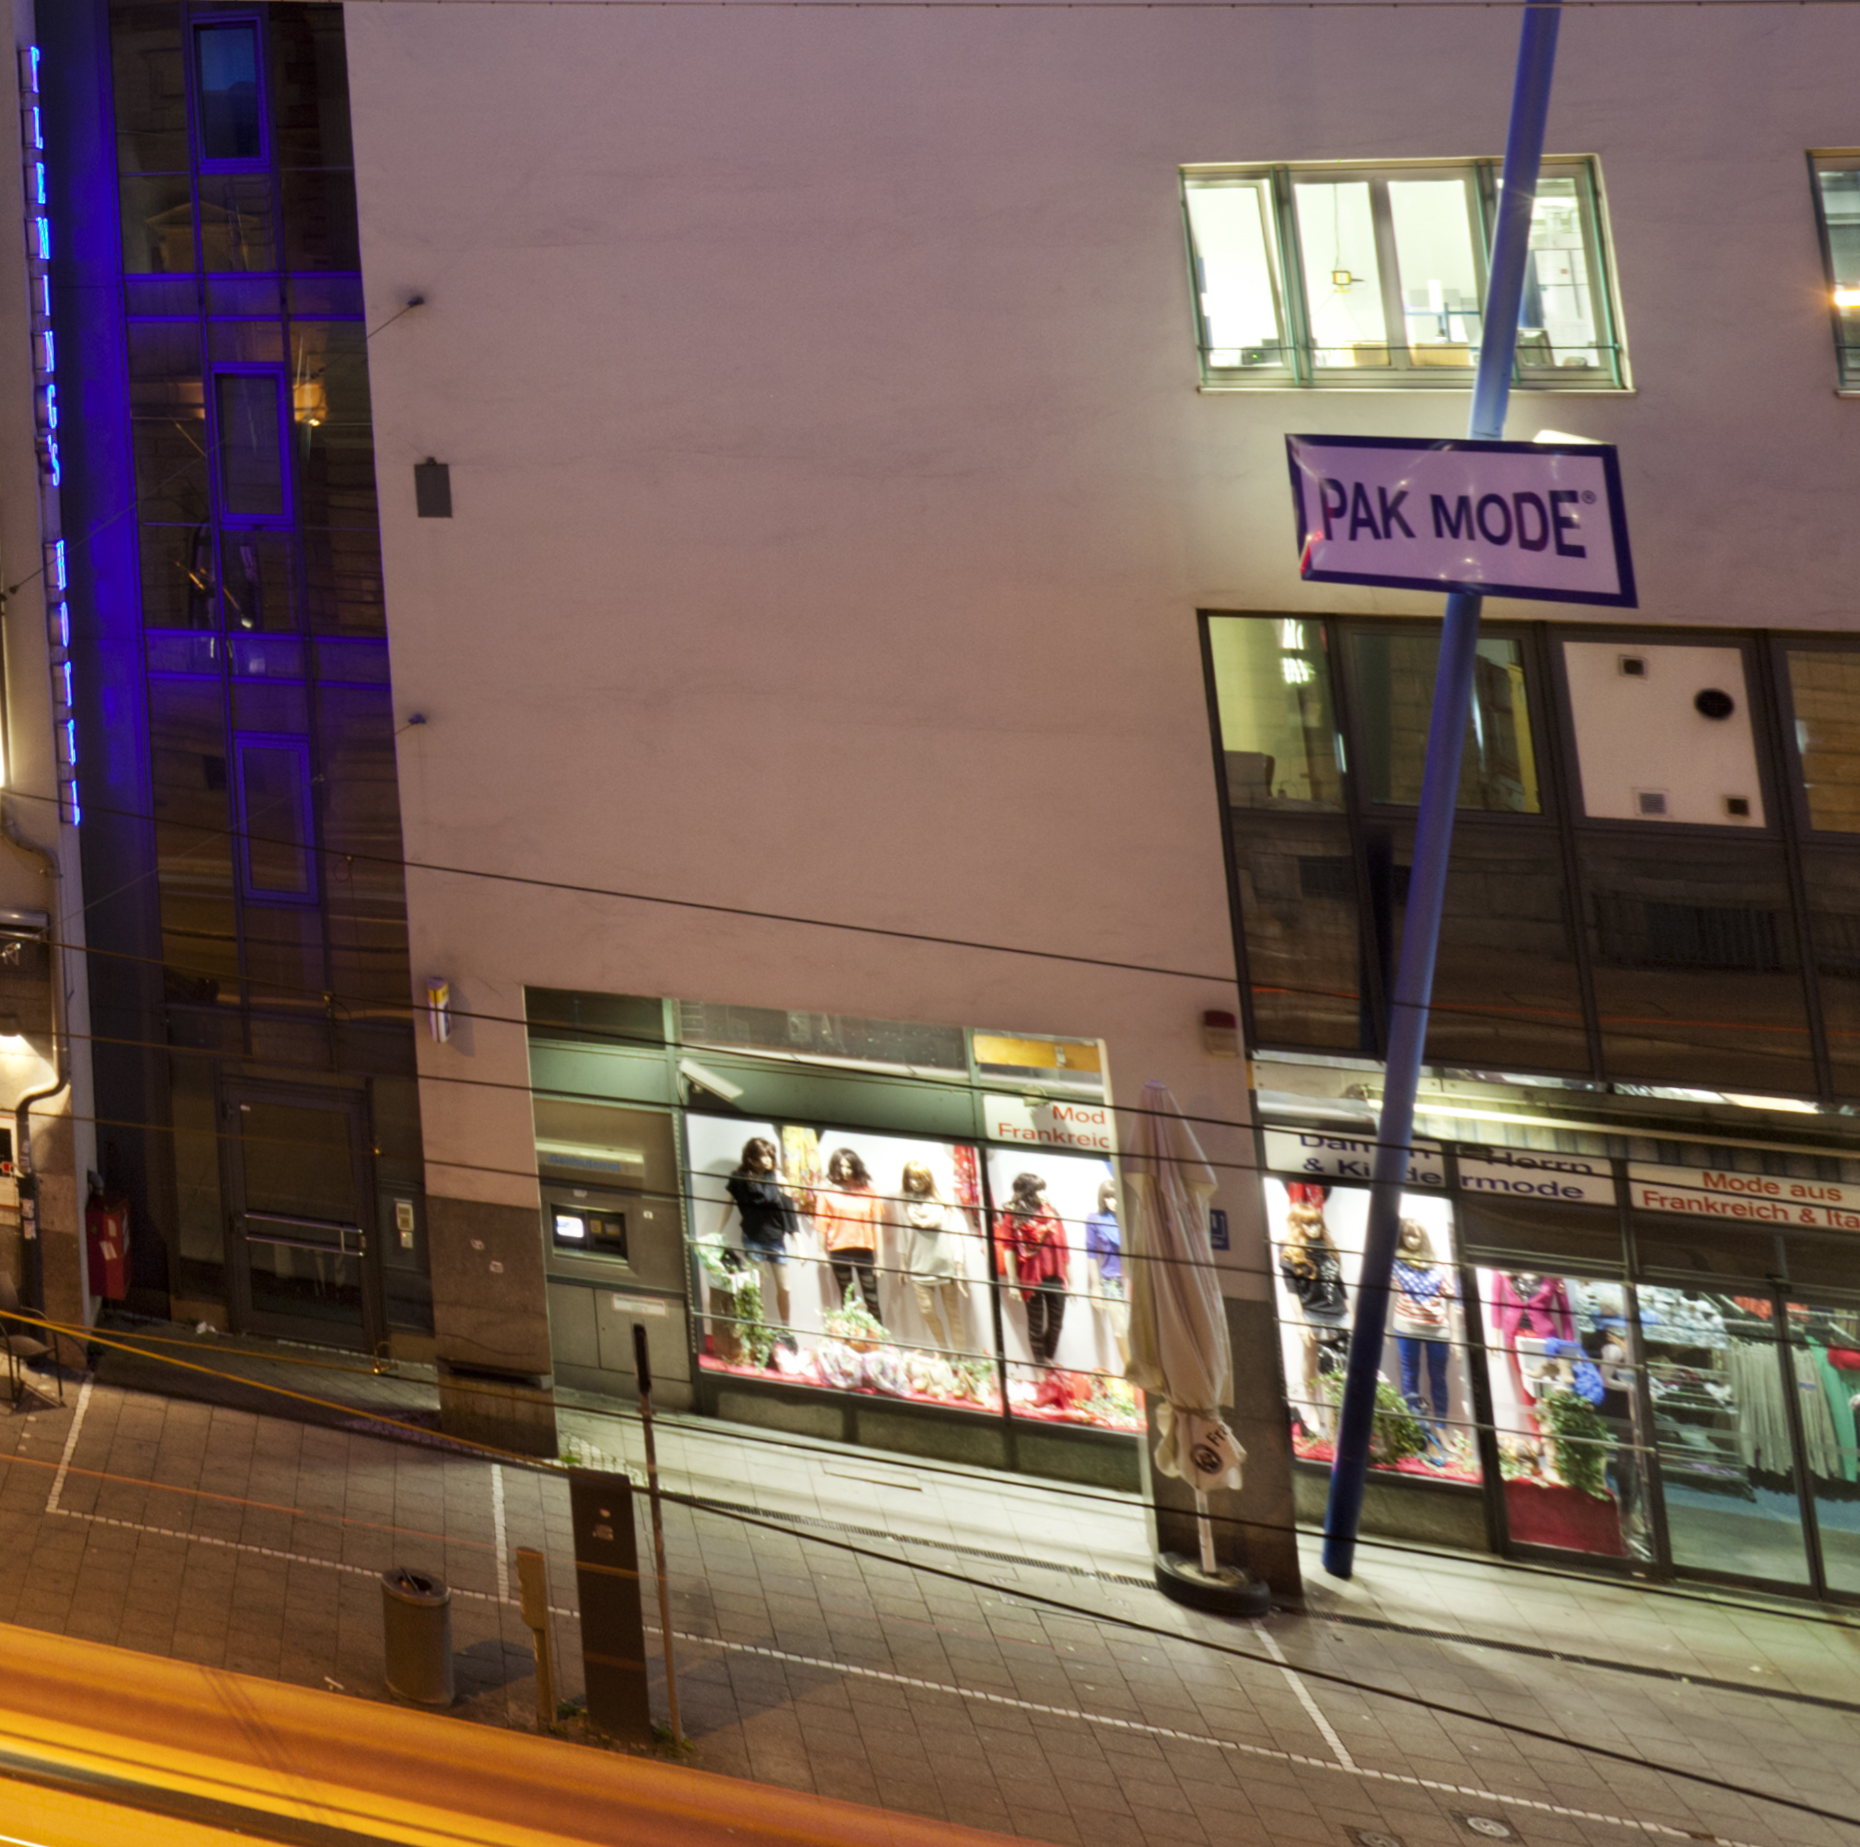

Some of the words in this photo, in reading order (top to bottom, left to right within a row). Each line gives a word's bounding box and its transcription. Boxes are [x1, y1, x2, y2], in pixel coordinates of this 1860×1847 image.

[1319, 477, 1417, 542] PAK
[1052, 1105, 1106, 1125] Mod
[998, 1122, 1111, 1150] Frankreic
[1702, 1171, 1780, 1196] Mode
[1790, 1183, 1843, 1202] aus
[1642, 1190, 1790, 1222] Frankreich
[1798, 1208, 1817, 1225] &
[1827, 1209, 1860, 1229] Ita
